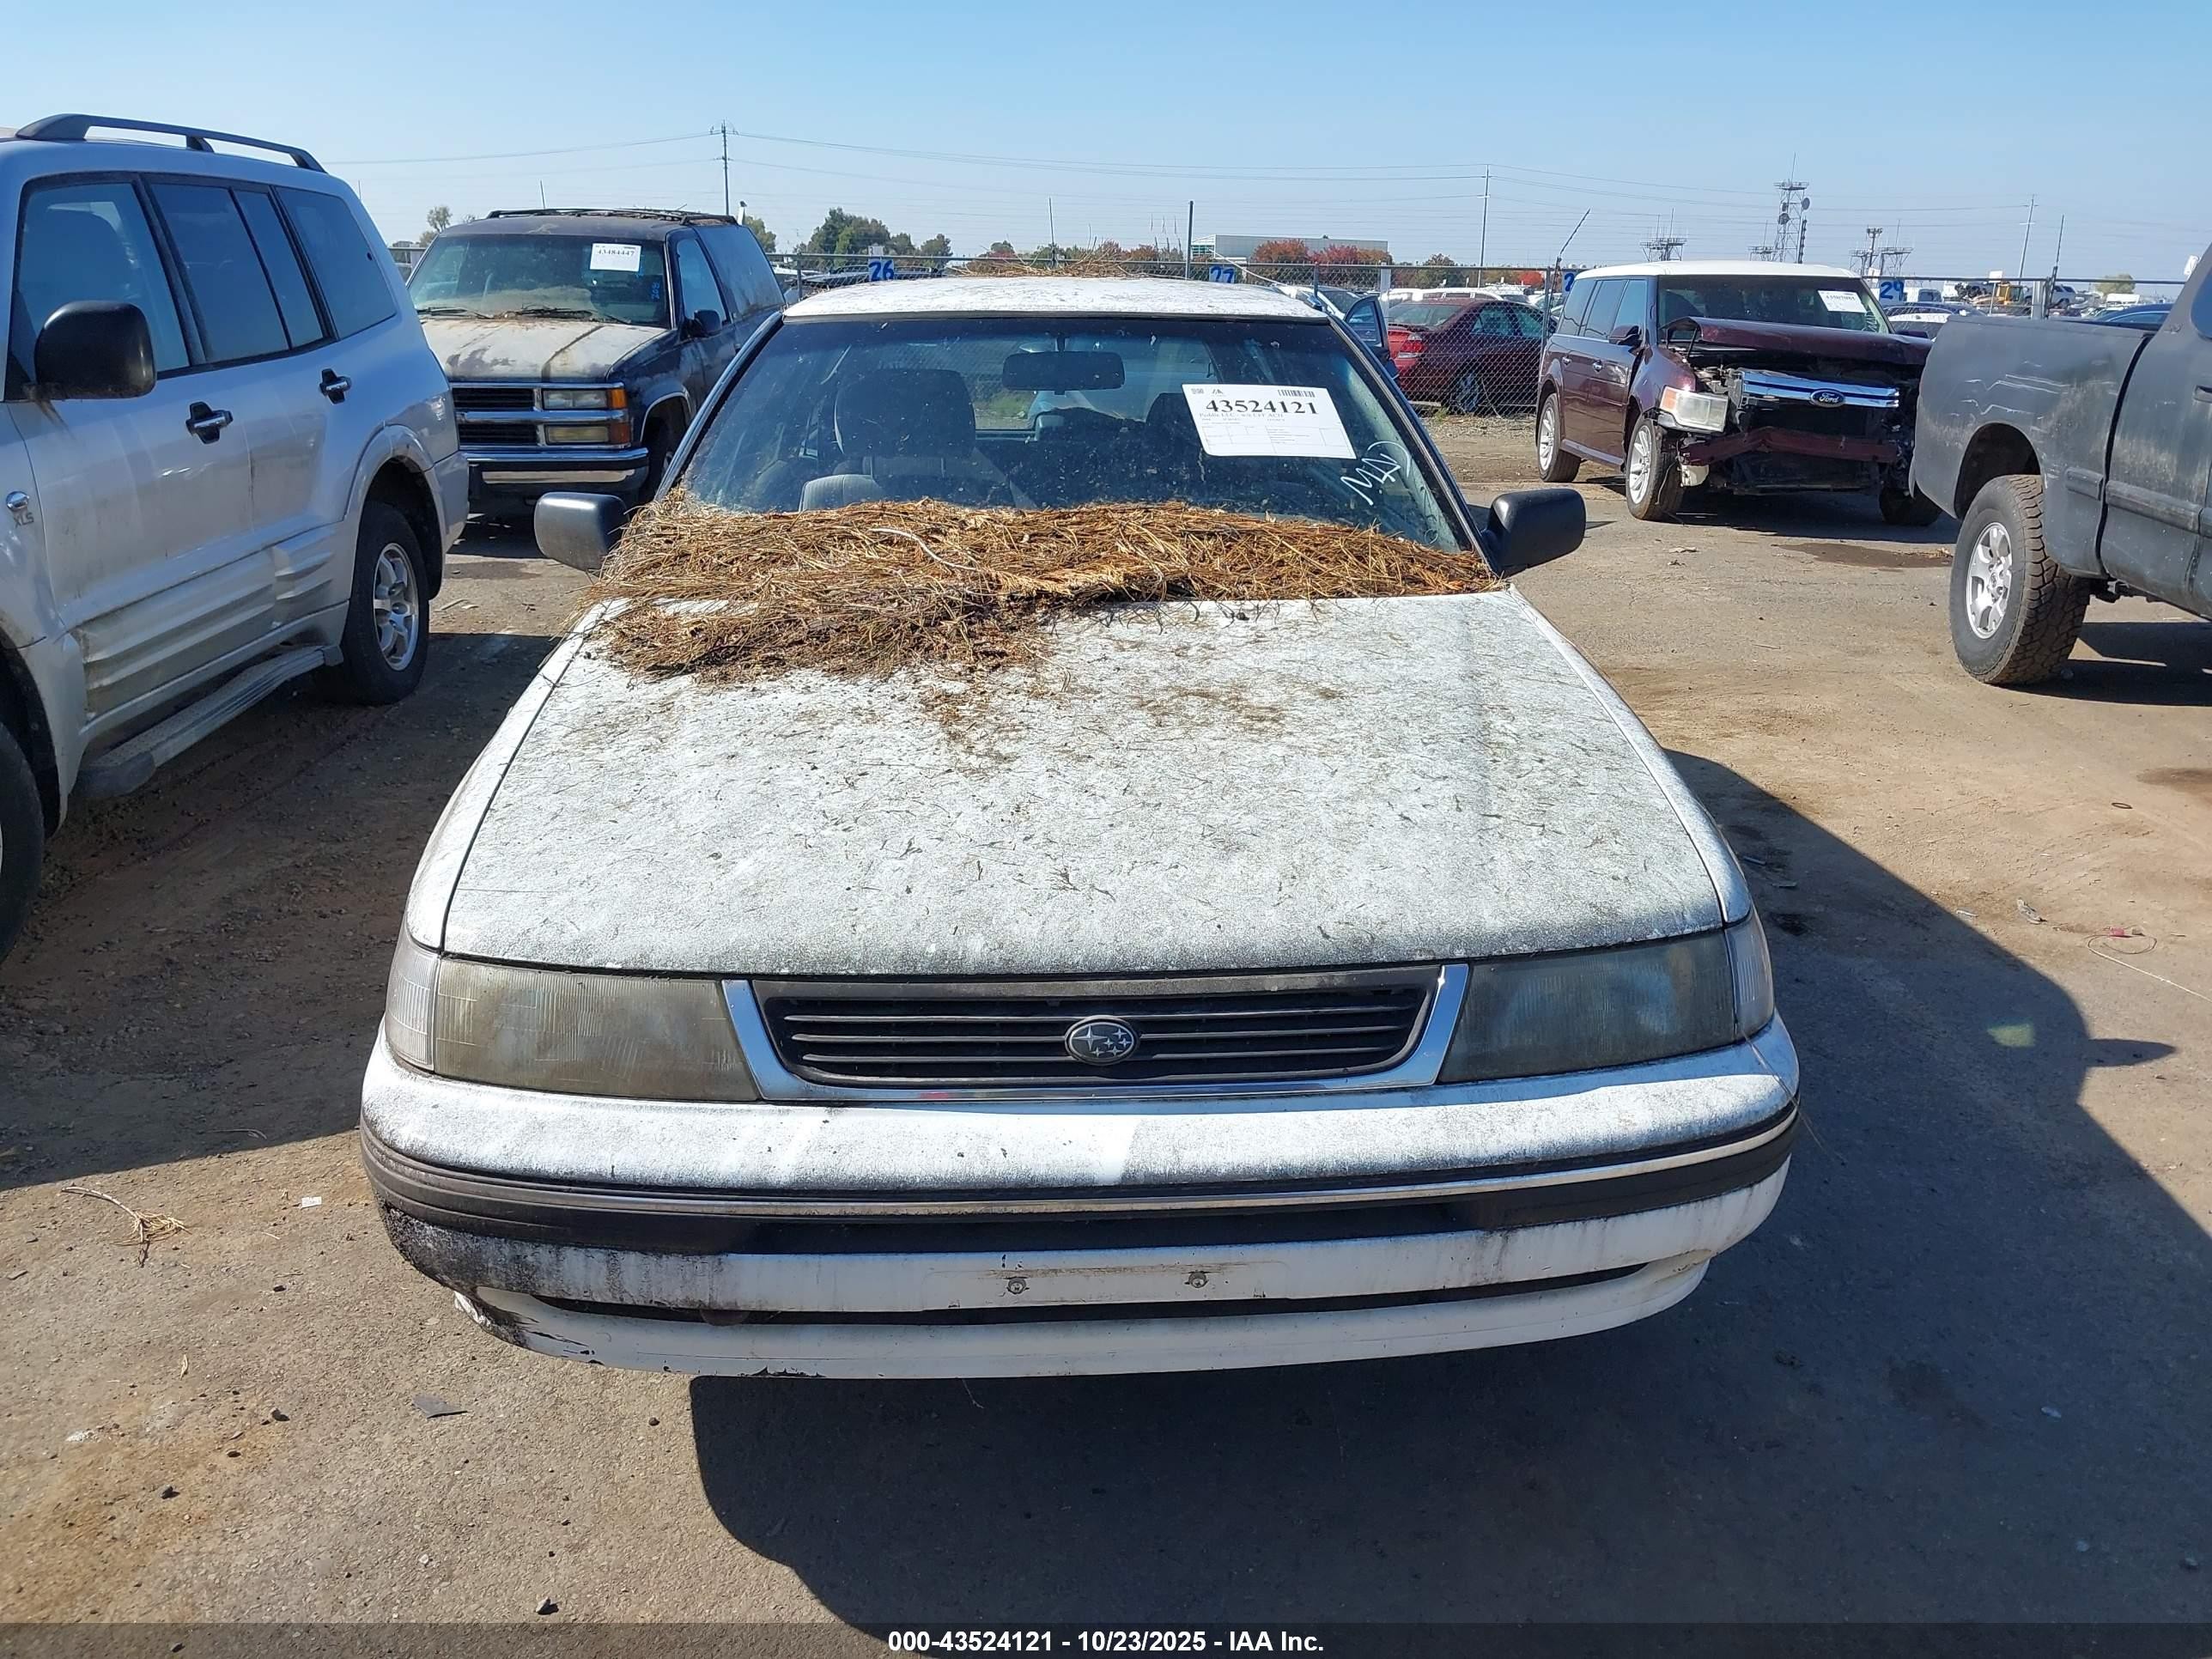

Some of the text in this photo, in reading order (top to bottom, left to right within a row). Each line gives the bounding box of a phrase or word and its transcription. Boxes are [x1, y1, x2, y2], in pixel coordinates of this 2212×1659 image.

[868, 259, 895, 282] 26
[1880, 280, 1905, 301] 29
[1819, 392, 1839, 403] Ford
[1206, 399, 1319, 414] 43524121
[14, 512, 34, 529] XLS
